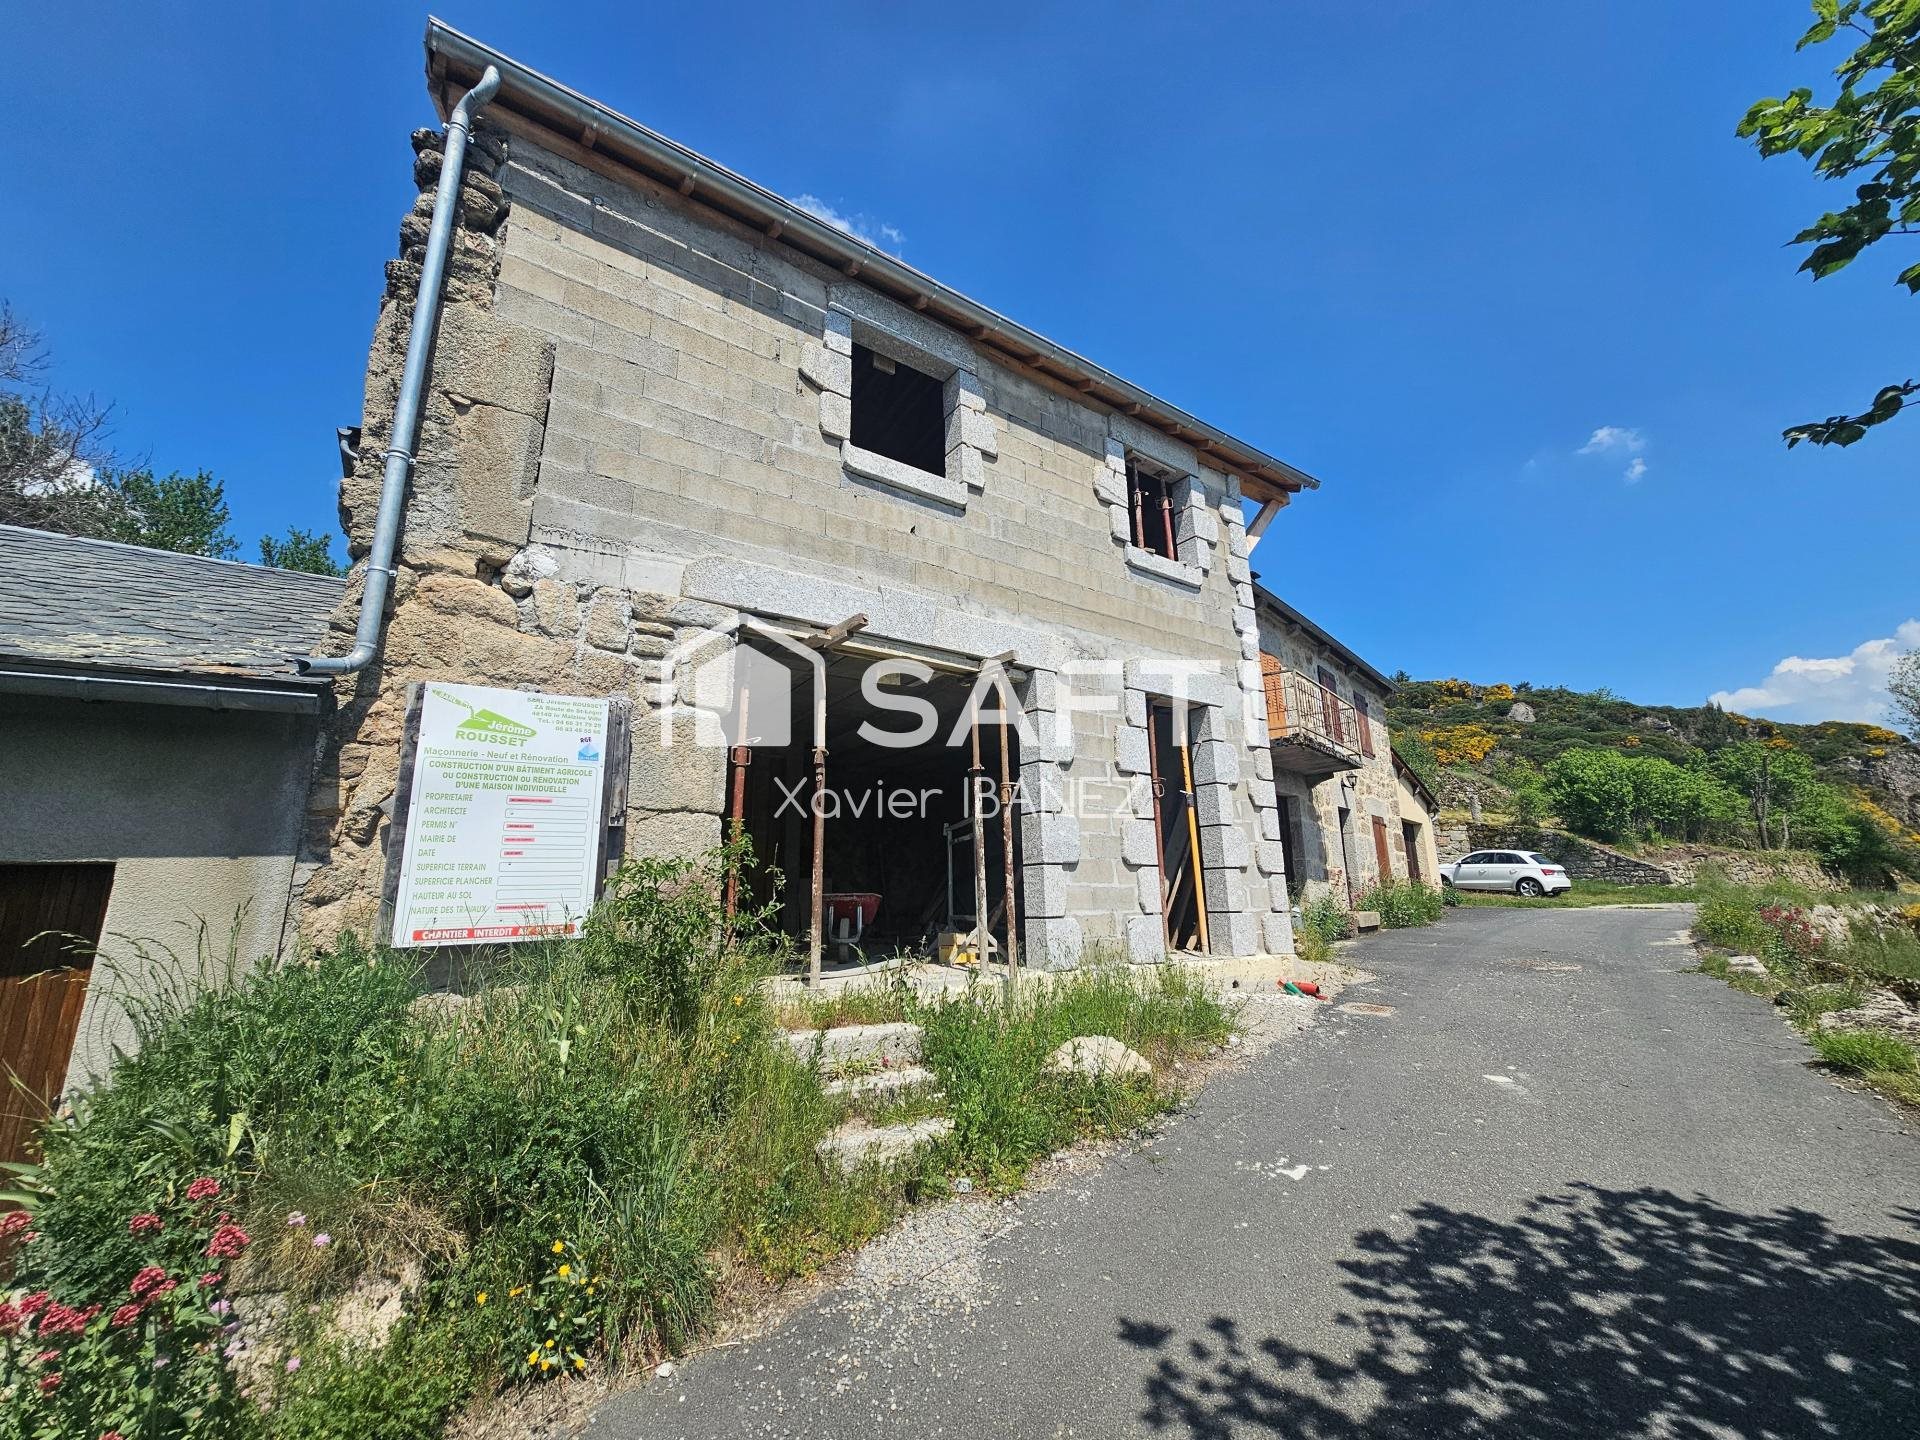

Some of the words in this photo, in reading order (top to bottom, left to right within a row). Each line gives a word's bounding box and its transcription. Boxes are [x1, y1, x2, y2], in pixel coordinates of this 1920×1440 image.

[456, 730, 528, 747] ROUSSET
[486, 751, 509, 760] Neuf
[510, 752, 519, 761] et
[520, 753, 569, 764] Rénovation
[429, 760, 494, 771] CONSTRUCTION
[495, 764, 515, 772] D'UN
[557, 768, 593, 777] AGRICOLE
[442, 771, 454, 779] OU
[456, 772, 519, 782] CONSTRUCTION
[455, 781, 480, 789] D'UNE
[482, 782, 514, 791] MAISON
[515, 784, 568, 793] INDIVIDUELLE
[423, 806, 468, 815] ARCHITECTE
[421, 820, 448, 829] PERMIS
[419, 834, 446, 843] MAIRIE
[447, 835, 457, 843] DE
[417, 848, 436, 857] DATE
[416, 863, 455, 871] SUPERFICIE
[457, 863, 487, 871] TERRAIN
[414, 877, 454, 886] SUPERFICIE
[455, 877, 493, 885] PLANCHER
[412, 891, 445, 900] HAUTEUR
[446, 891, 457, 899] AU
[458, 891, 472, 899] SOL
[410, 906, 439, 915] NATURE
[440, 905, 454, 914] DES
[456, 905, 487, 913] TRAVAUX
[422, 929, 469, 940] CHANTIER
[473, 927, 513, 937] INTERDIT
